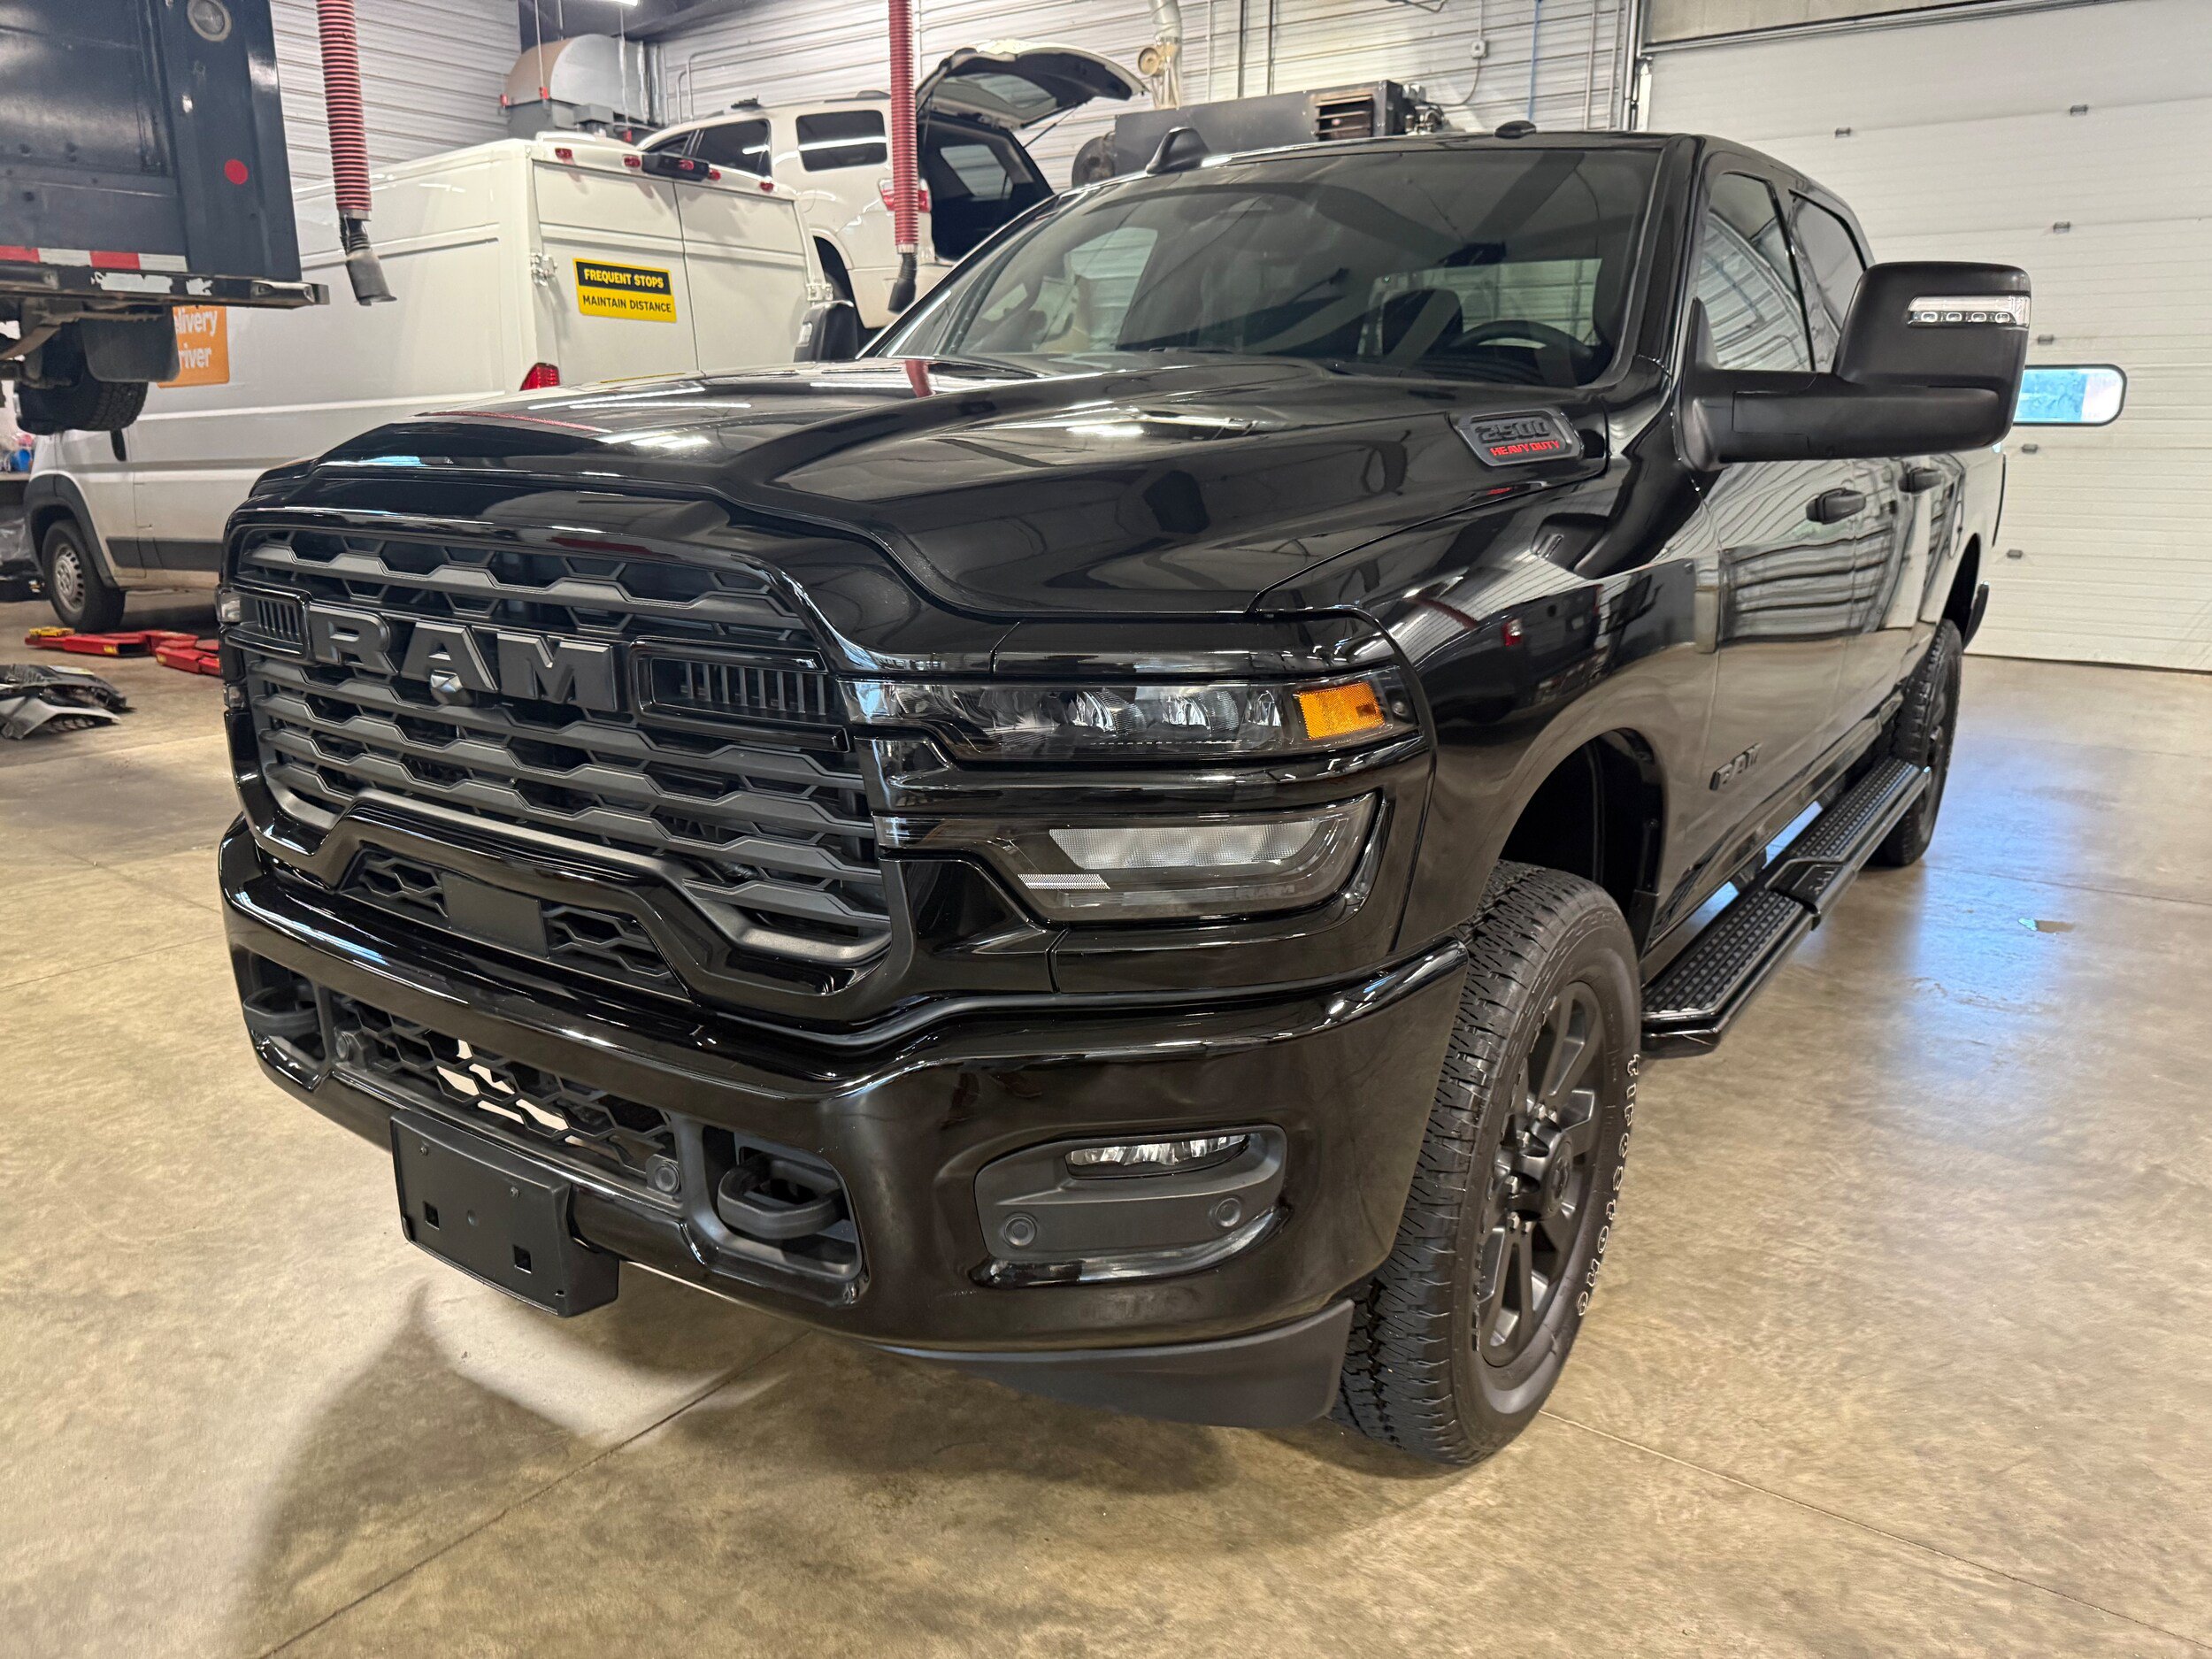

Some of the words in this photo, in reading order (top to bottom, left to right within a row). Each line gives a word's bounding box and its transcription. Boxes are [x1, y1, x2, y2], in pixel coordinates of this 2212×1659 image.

[584, 268, 632, 285] FREQUENT
[634, 273, 664, 289] STOPS
[582, 295, 627, 309] MAINTAIN
[629, 299, 672, 313] DISTANCE
[1474, 419, 1550, 444] 2500
[1489, 442, 1530, 457] HEAVY
[1532, 440, 1560, 452] DUTY
[306, 601, 618, 711] RAM
[1709, 742, 1763, 791] RAM
